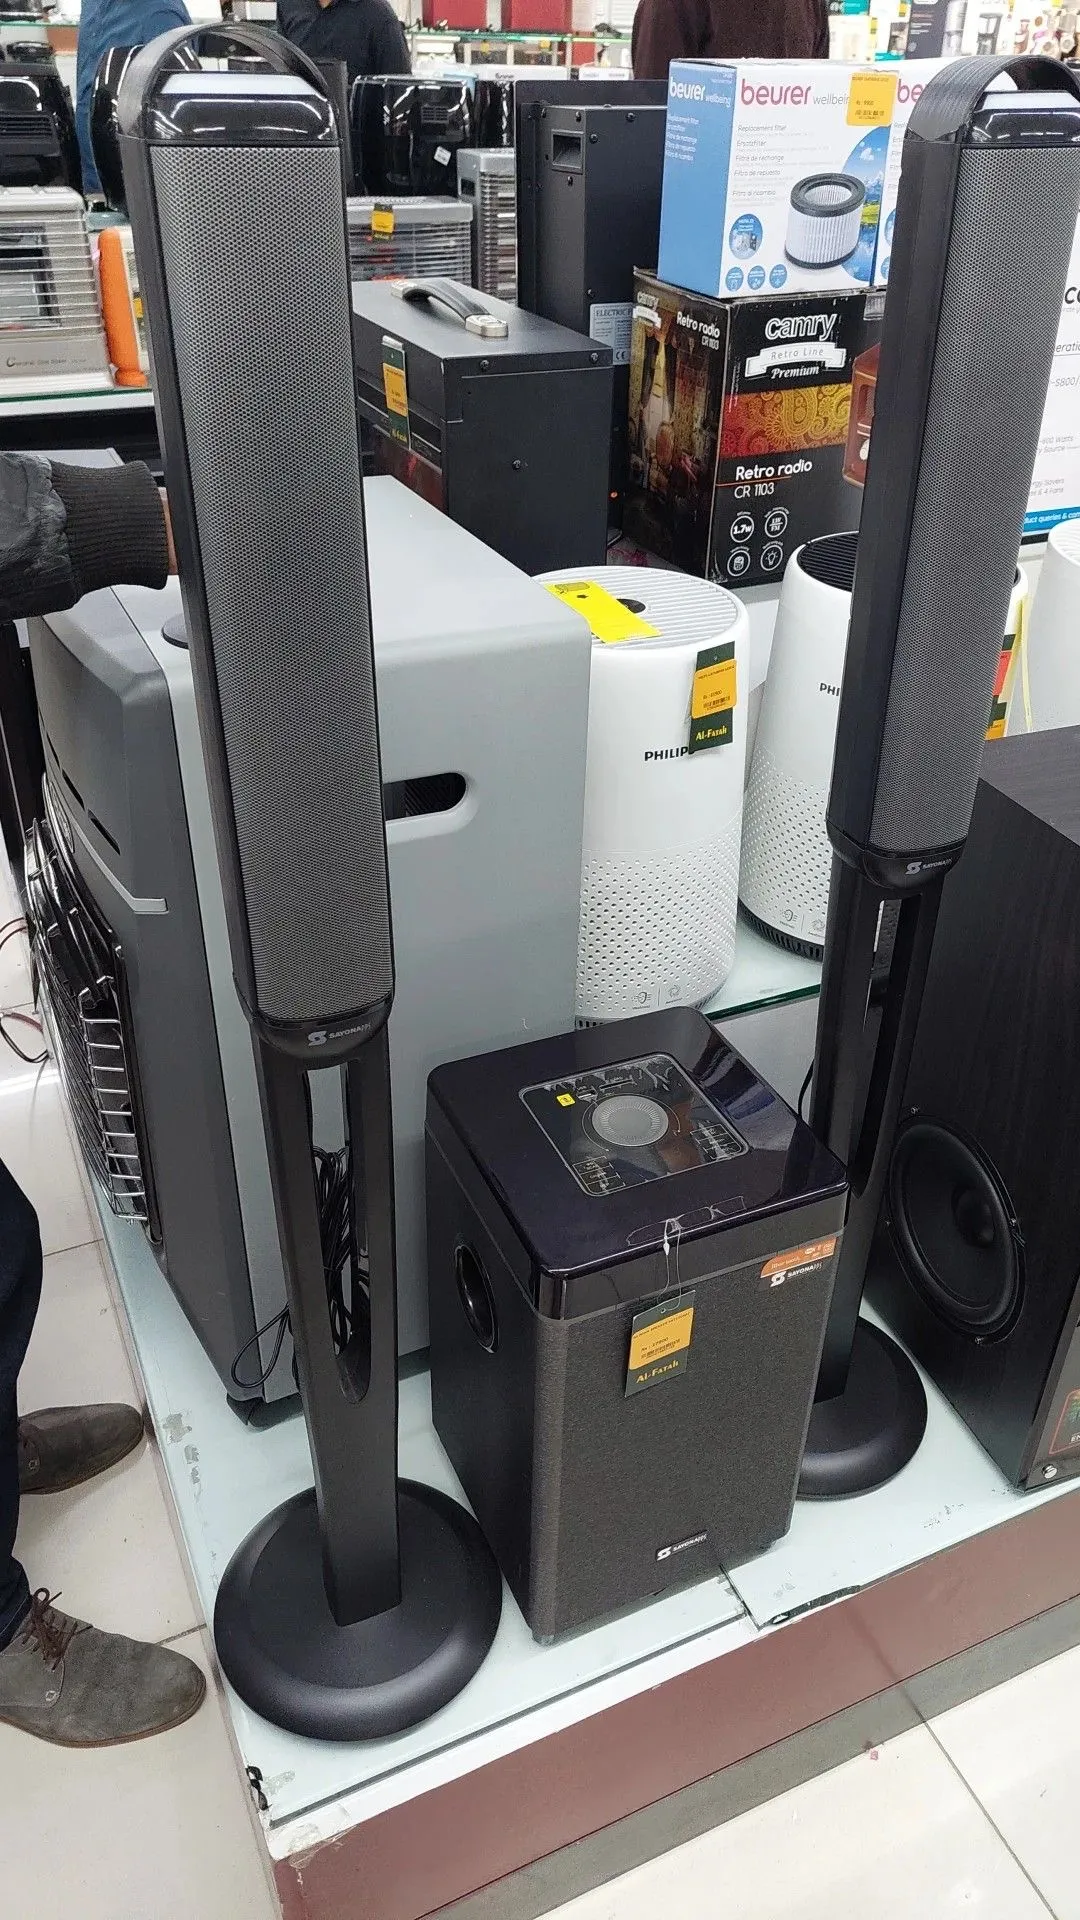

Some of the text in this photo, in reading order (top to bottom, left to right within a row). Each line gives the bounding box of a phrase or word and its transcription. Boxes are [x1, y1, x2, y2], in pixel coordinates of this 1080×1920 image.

[669, 77, 705, 101] beurer
[741, 78, 811, 105] beurer
[676, 311, 698, 330] Retro
[699, 321, 720, 338] radio
[765, 314, 837, 341] camry
[771, 347, 825, 361] Retro Line
[770, 365, 820, 380] Premium
[735, 459, 813, 481] Retro radio
[734, 483, 775, 499] CR 1103
[820, 682, 841, 697] PHI
[644, 746, 690, 761] PHILIP
